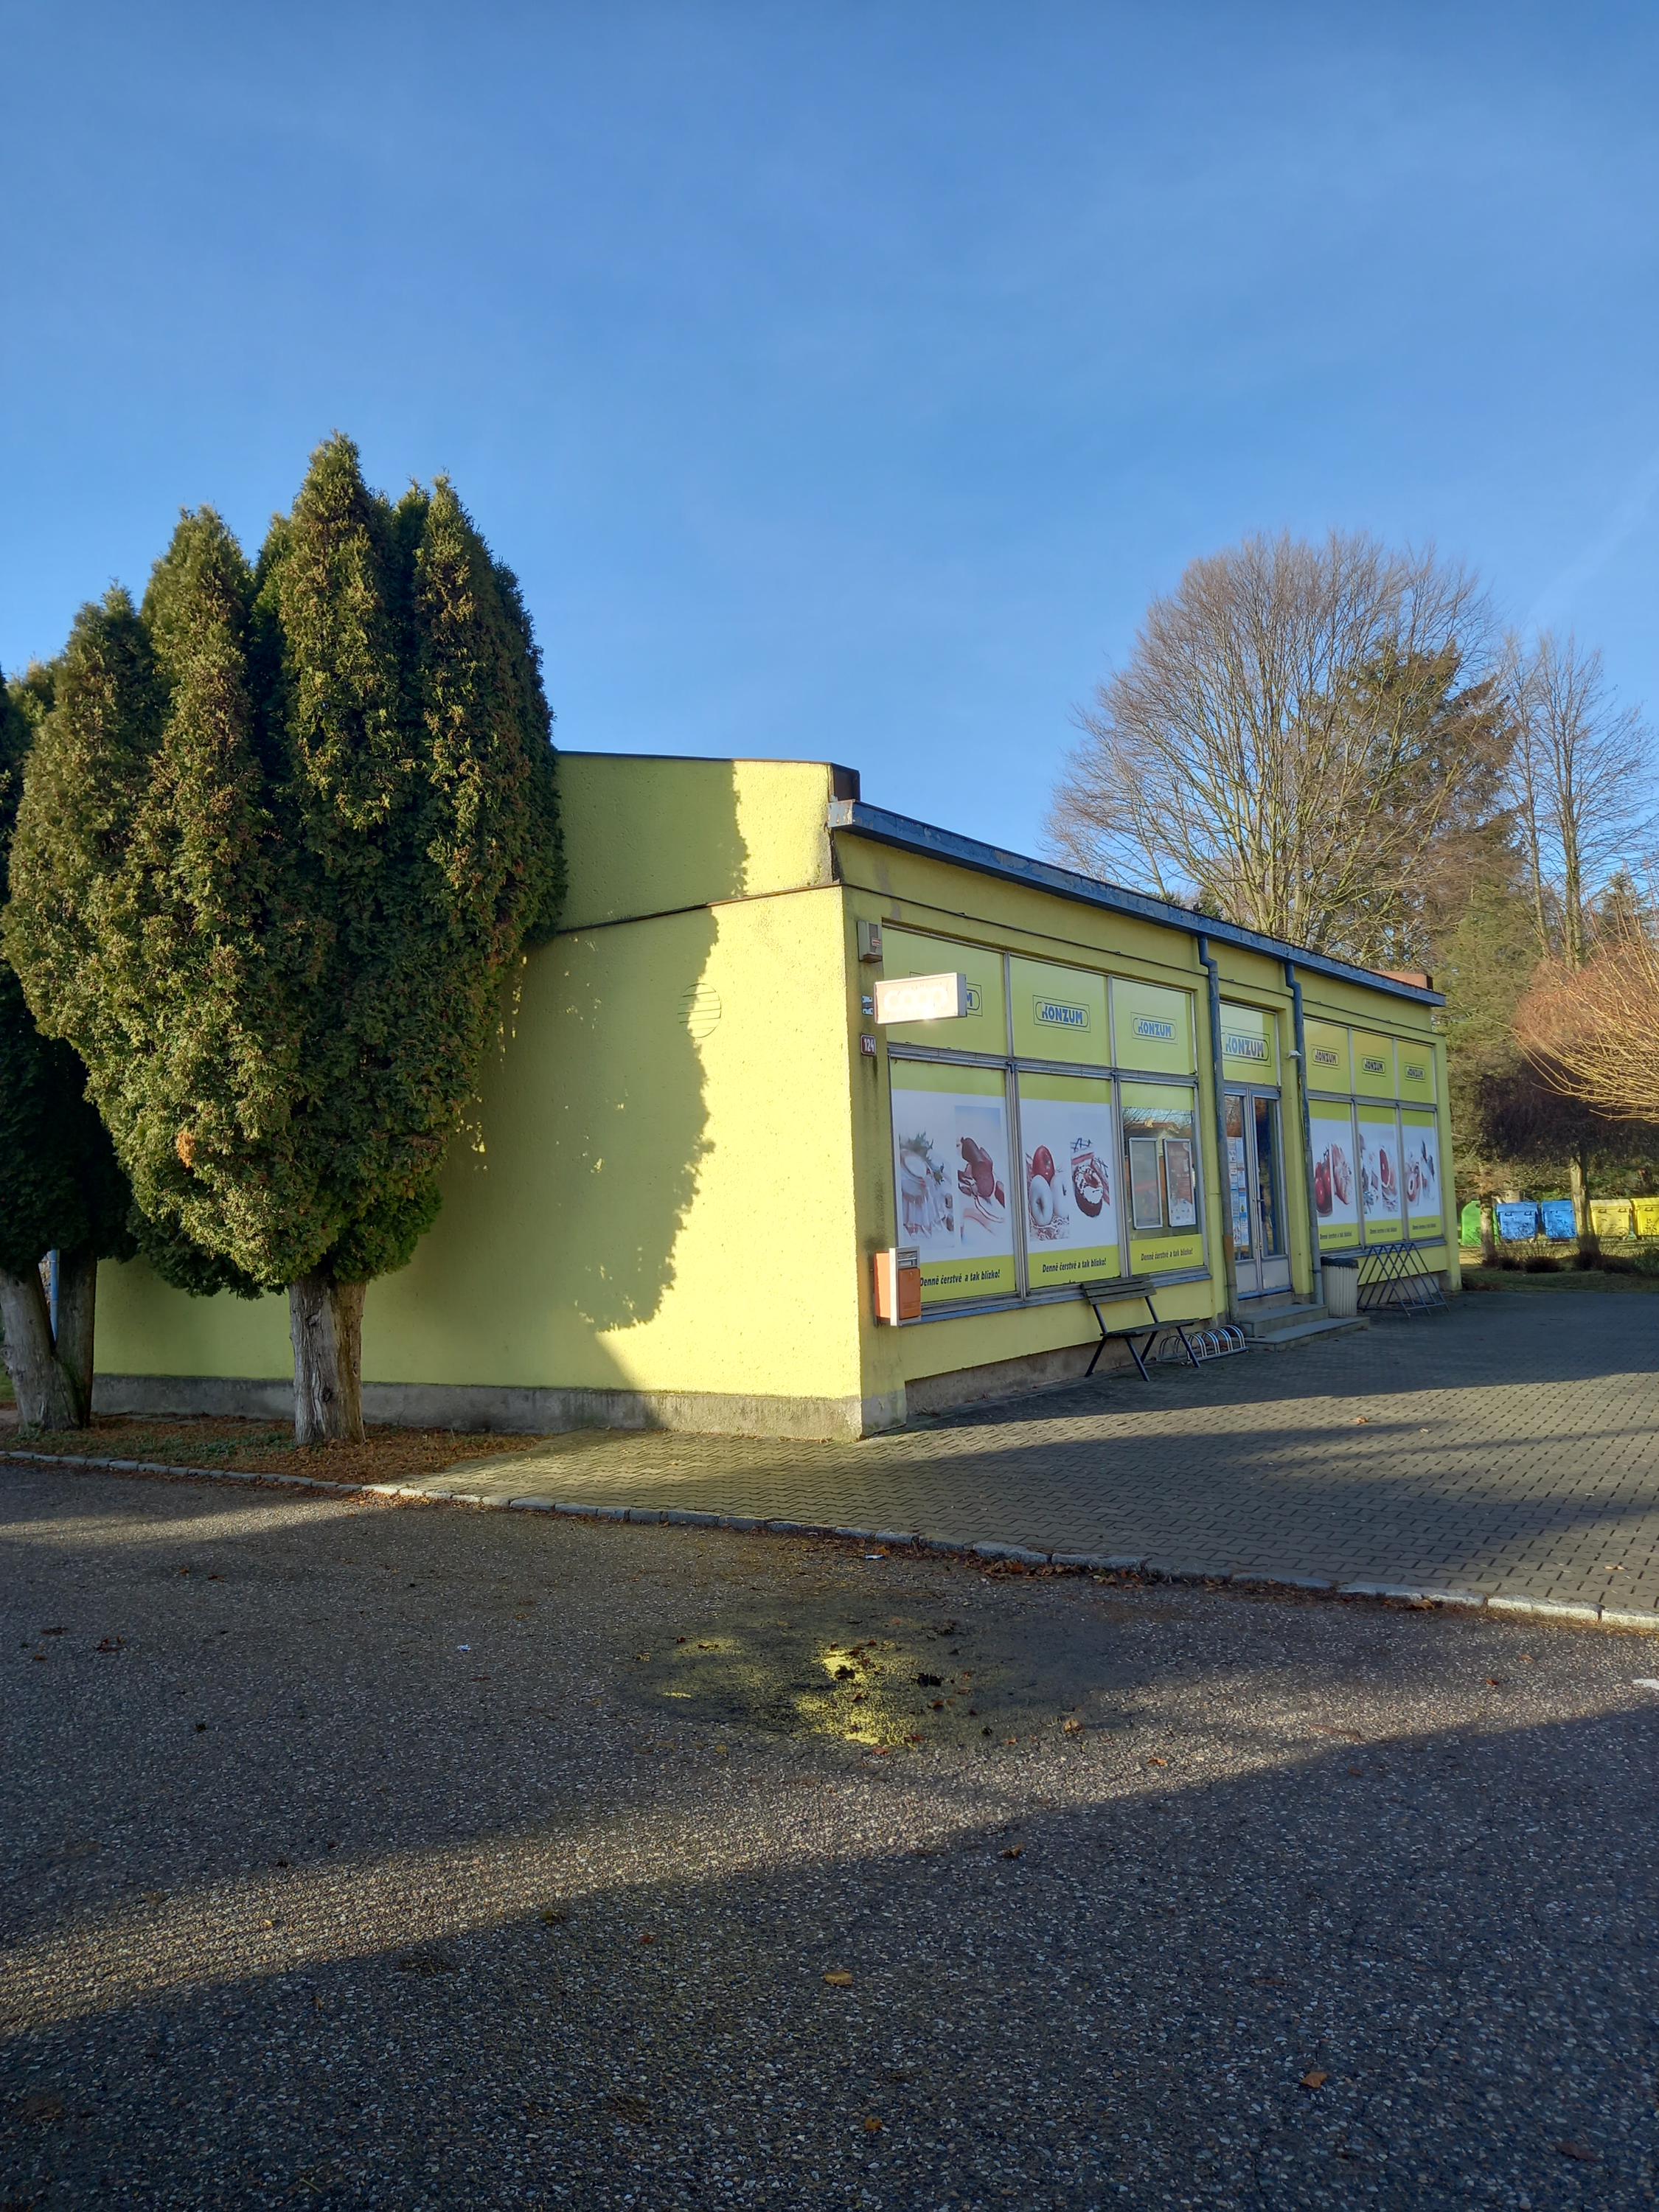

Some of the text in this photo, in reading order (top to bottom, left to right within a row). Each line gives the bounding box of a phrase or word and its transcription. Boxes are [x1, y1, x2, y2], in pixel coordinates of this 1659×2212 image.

[1042, 1004, 1083, 1025] KONZUM
[1138, 1020, 1172, 1037] KONZUM
[864, 1038, 874, 1052] 124
[1225, 1034, 1265, 1058] KONZUM
[1315, 1049, 1337, 1064] KONZUM
[1042, 1262, 1059, 1273] Denně
[1060, 1262, 1077, 1271] čerstvé
[1082, 1259, 1090, 1268] tak
[920, 1275, 939, 1287] Denně
[941, 1273, 962, 1284] čerstvé
[964, 1274, 969, 1282] a
[970, 1271, 980, 1281] tak
